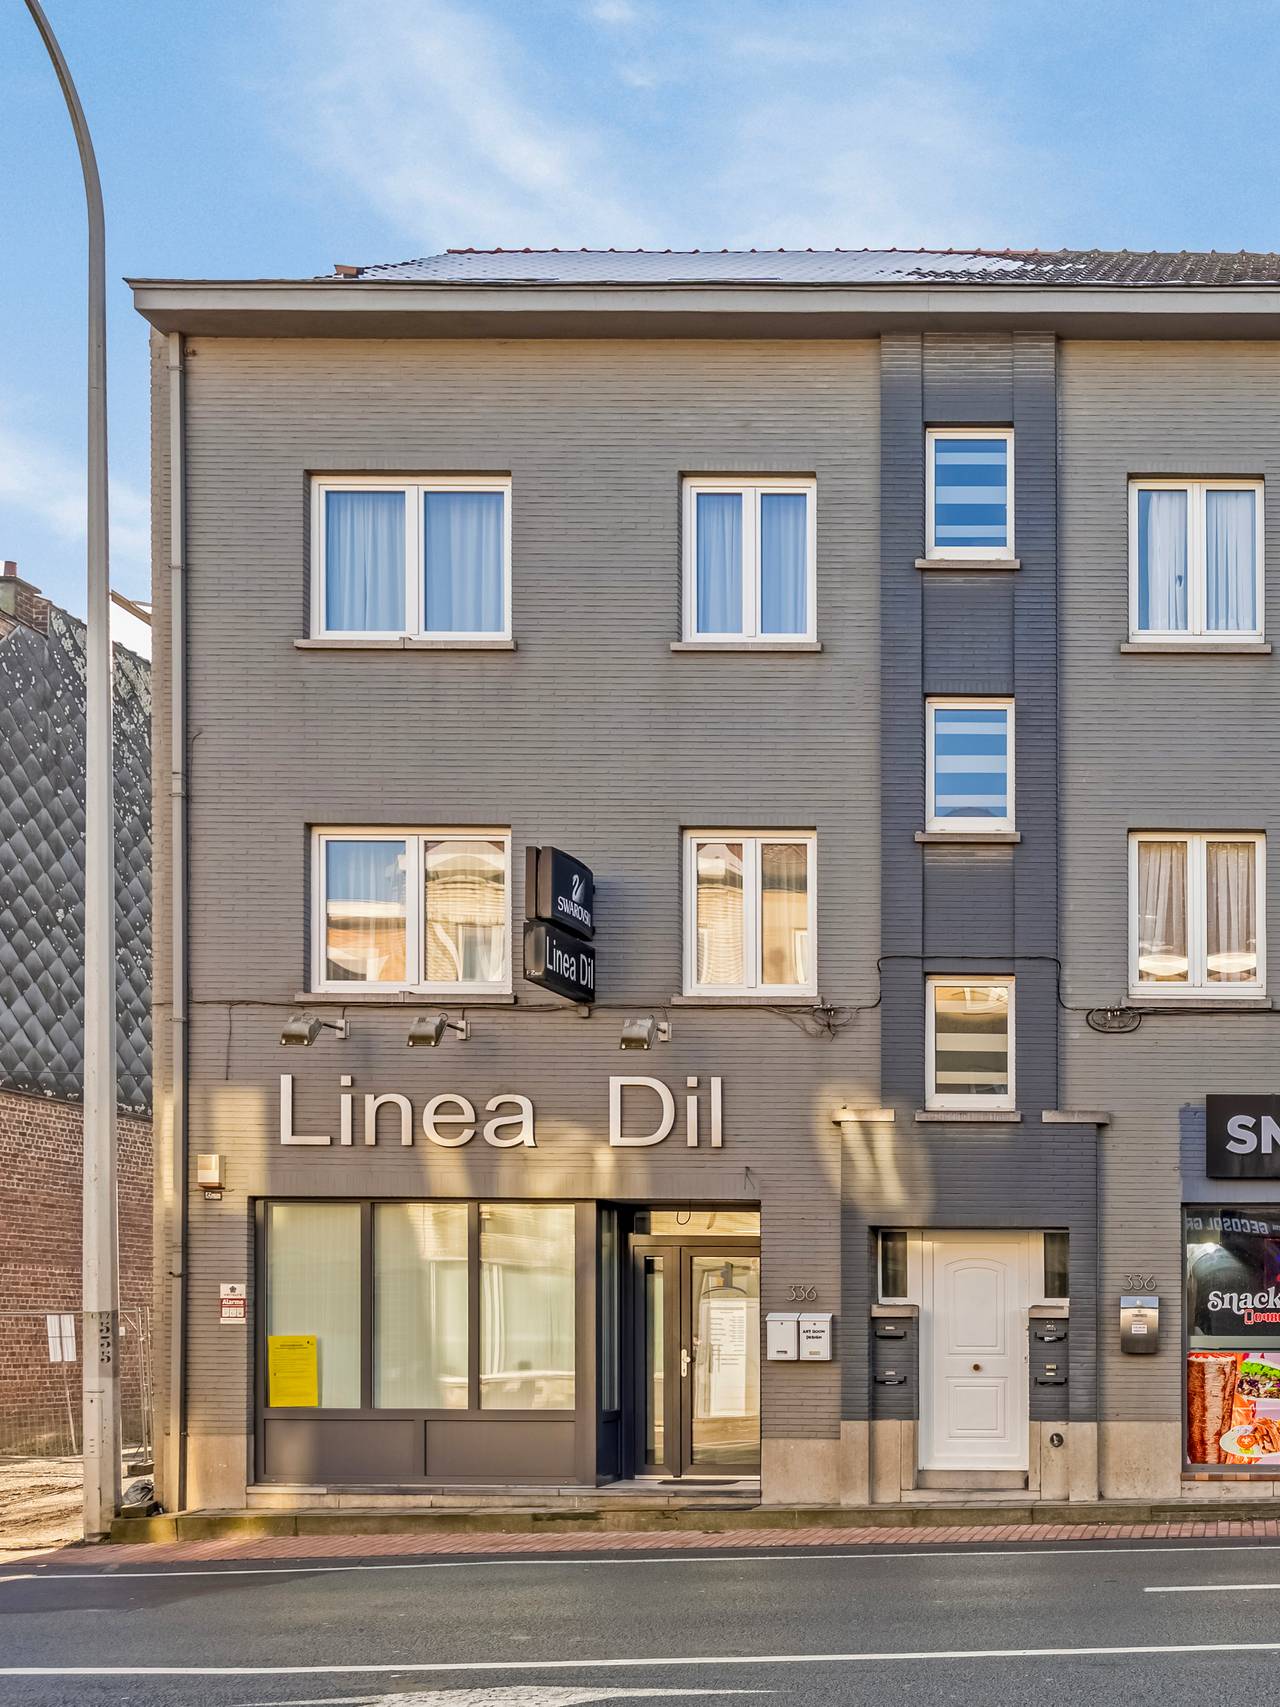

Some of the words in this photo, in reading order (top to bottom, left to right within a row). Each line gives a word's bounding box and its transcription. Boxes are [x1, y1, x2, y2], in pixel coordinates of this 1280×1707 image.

[546, 935, 577, 982] Linea
[580, 953, 594, 990] Dil
[280, 1074, 537, 1148] Linea
[609, 1076, 724, 1148] Dil
[786, 1284, 818, 1301] 336
[1122, 1273, 1157, 1291] 336
